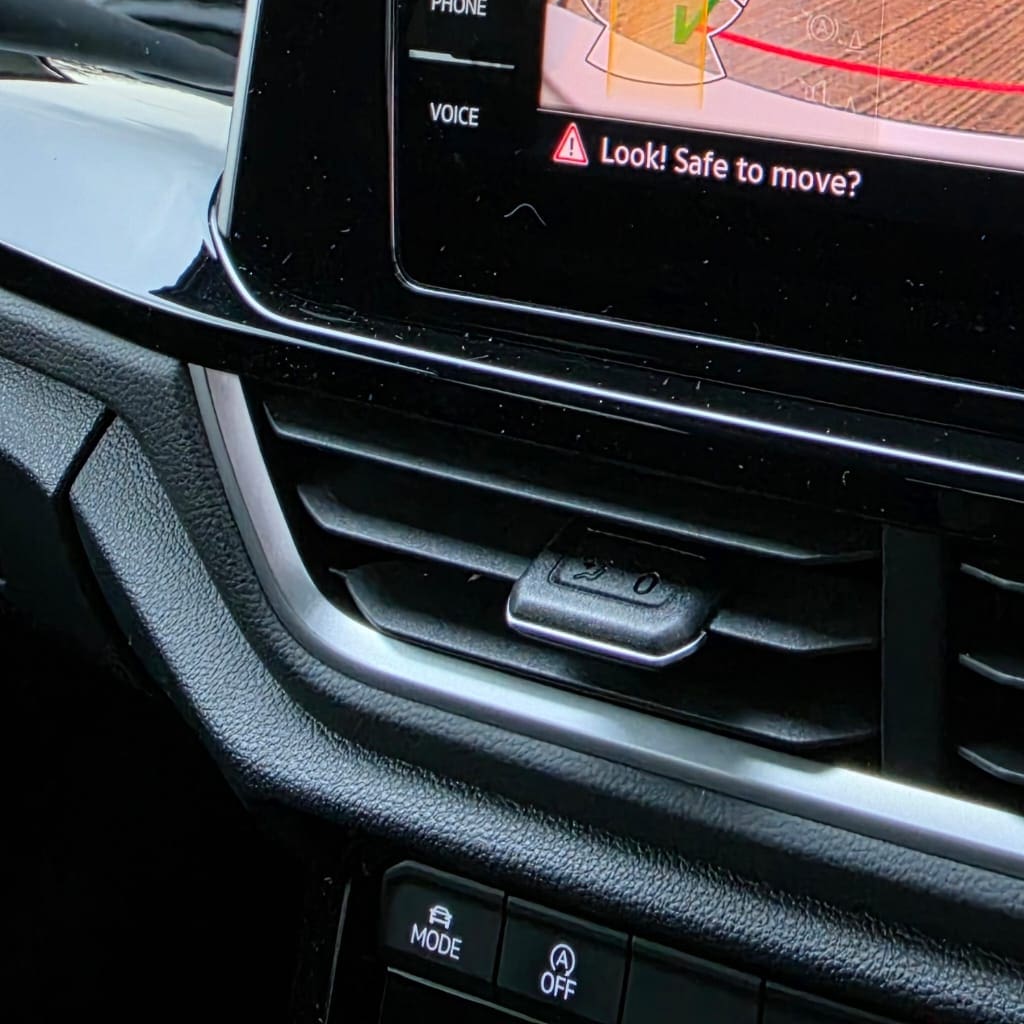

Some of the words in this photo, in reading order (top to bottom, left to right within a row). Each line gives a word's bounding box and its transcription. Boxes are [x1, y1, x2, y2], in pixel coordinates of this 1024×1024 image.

[430, 102, 480, 127] VOICE
[600, 136, 667, 171] Look!
[674, 147, 728, 179] Safe
[736, 157, 763, 183] to
[771, 164, 861, 197] move?
[410, 923, 463, 960] MODE
[541, 972, 577, 1001] OFF
